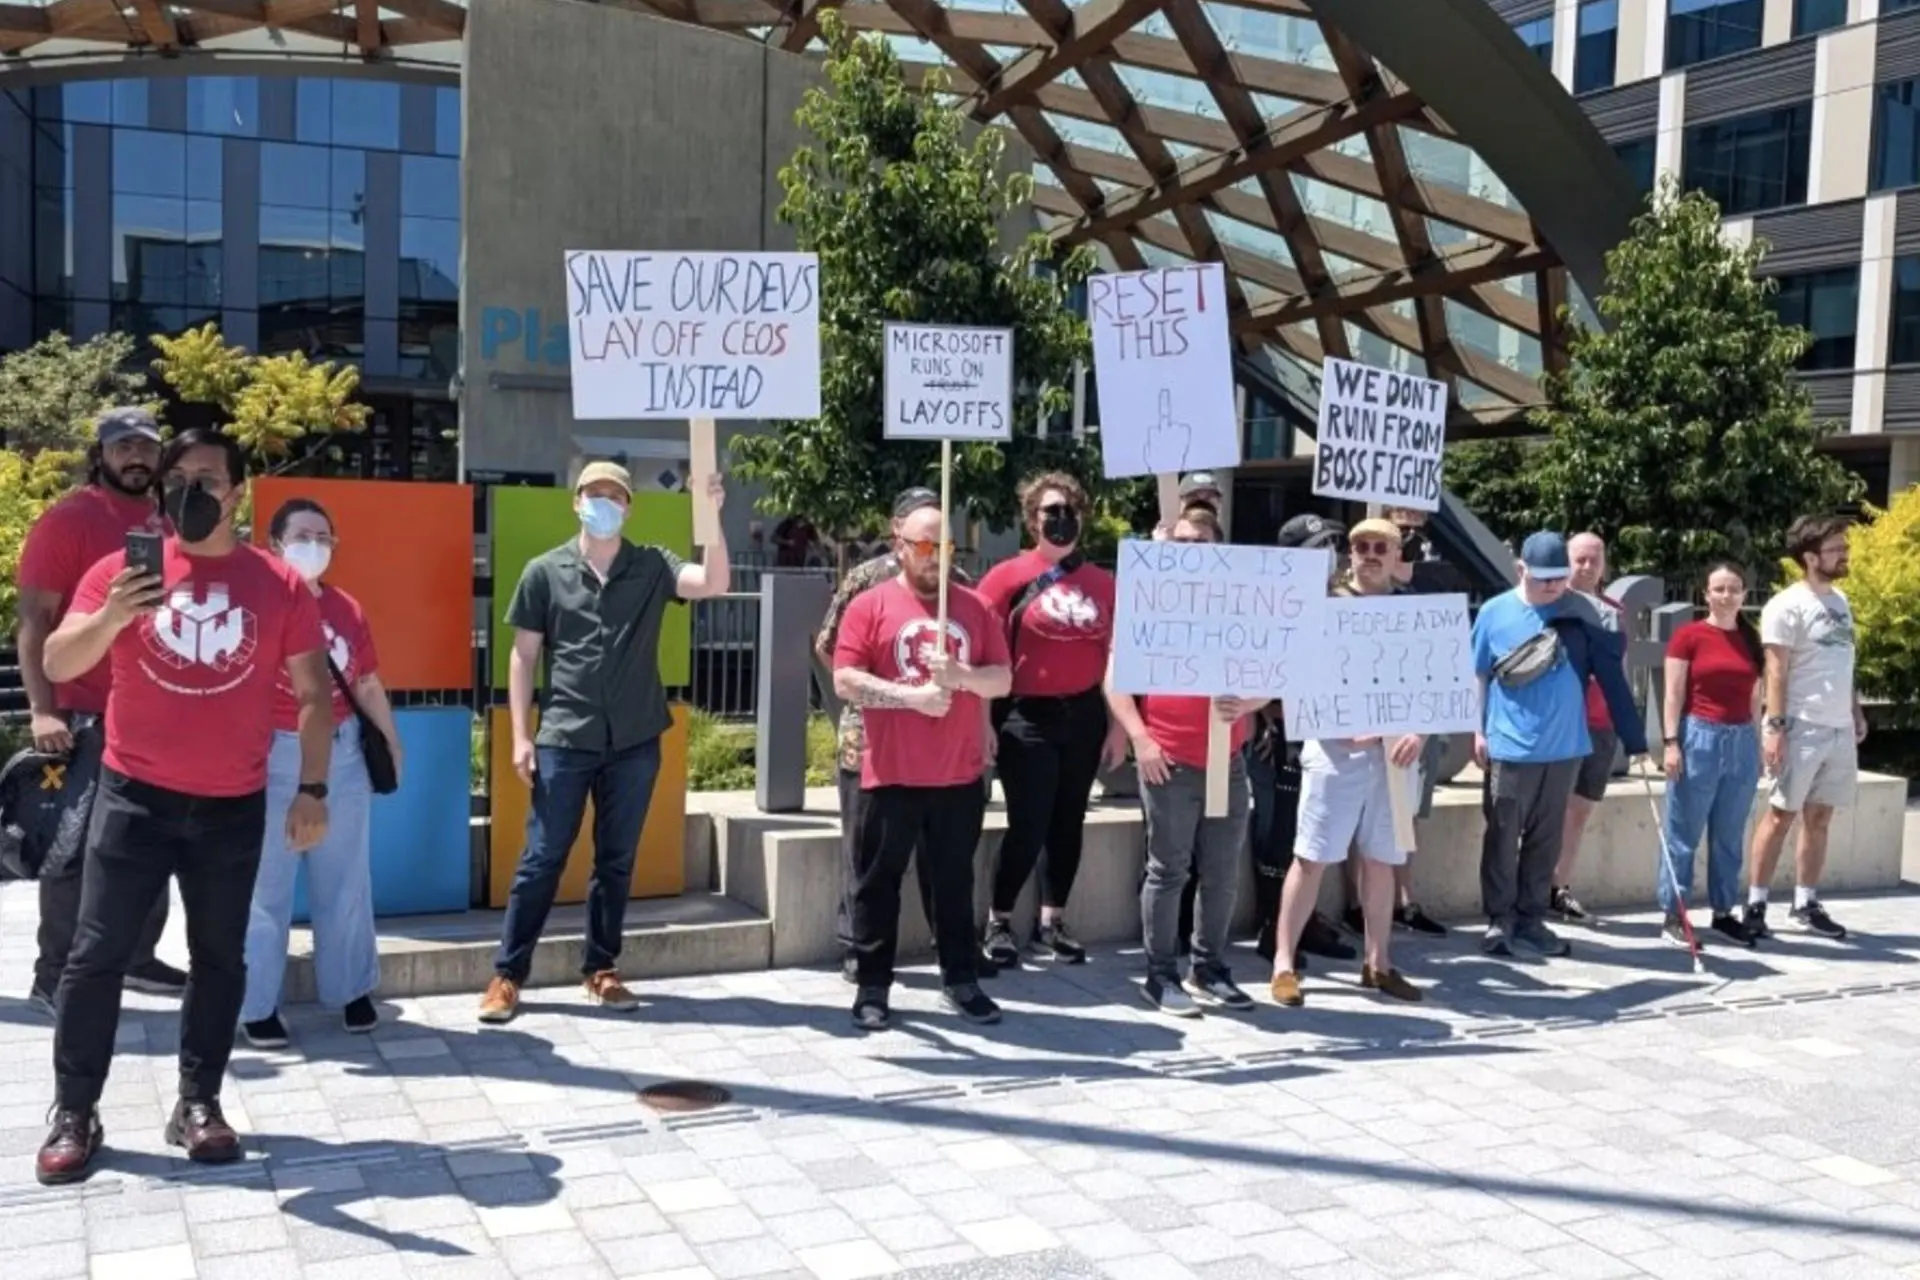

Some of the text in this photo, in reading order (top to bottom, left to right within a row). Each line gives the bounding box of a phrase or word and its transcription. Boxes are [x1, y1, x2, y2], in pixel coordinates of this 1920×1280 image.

[567, 252, 816, 316] SAVE OUR DEVS
[1089, 264, 1214, 320] RESET
[579, 317, 788, 360] LAY OFF CEOS
[893, 329, 1004, 356] MICROSOFT
[1111, 316, 1188, 360] THIS
[640, 363, 763, 412] INSTEAD
[911, 357, 984, 379] RUNS ON
[1334, 361, 1380, 404] WE
[899, 399, 1003, 429] LAYOFFS
[1327, 403, 1441, 454] RUN FROM
[1316, 443, 1443, 501] BOSS FIGHTS
[1130, 544, 1293, 576] XBOX IS
[1133, 578, 1303, 619] NOTHING
[1132, 620, 1298, 650] WITHOUT
[1337, 609, 1465, 635] PEOPLE A DAY
[1144, 653, 1289, 689] ITS DEVS
[1294, 692, 1352, 729] ARE
[1361, 692, 1414, 725] THEY
